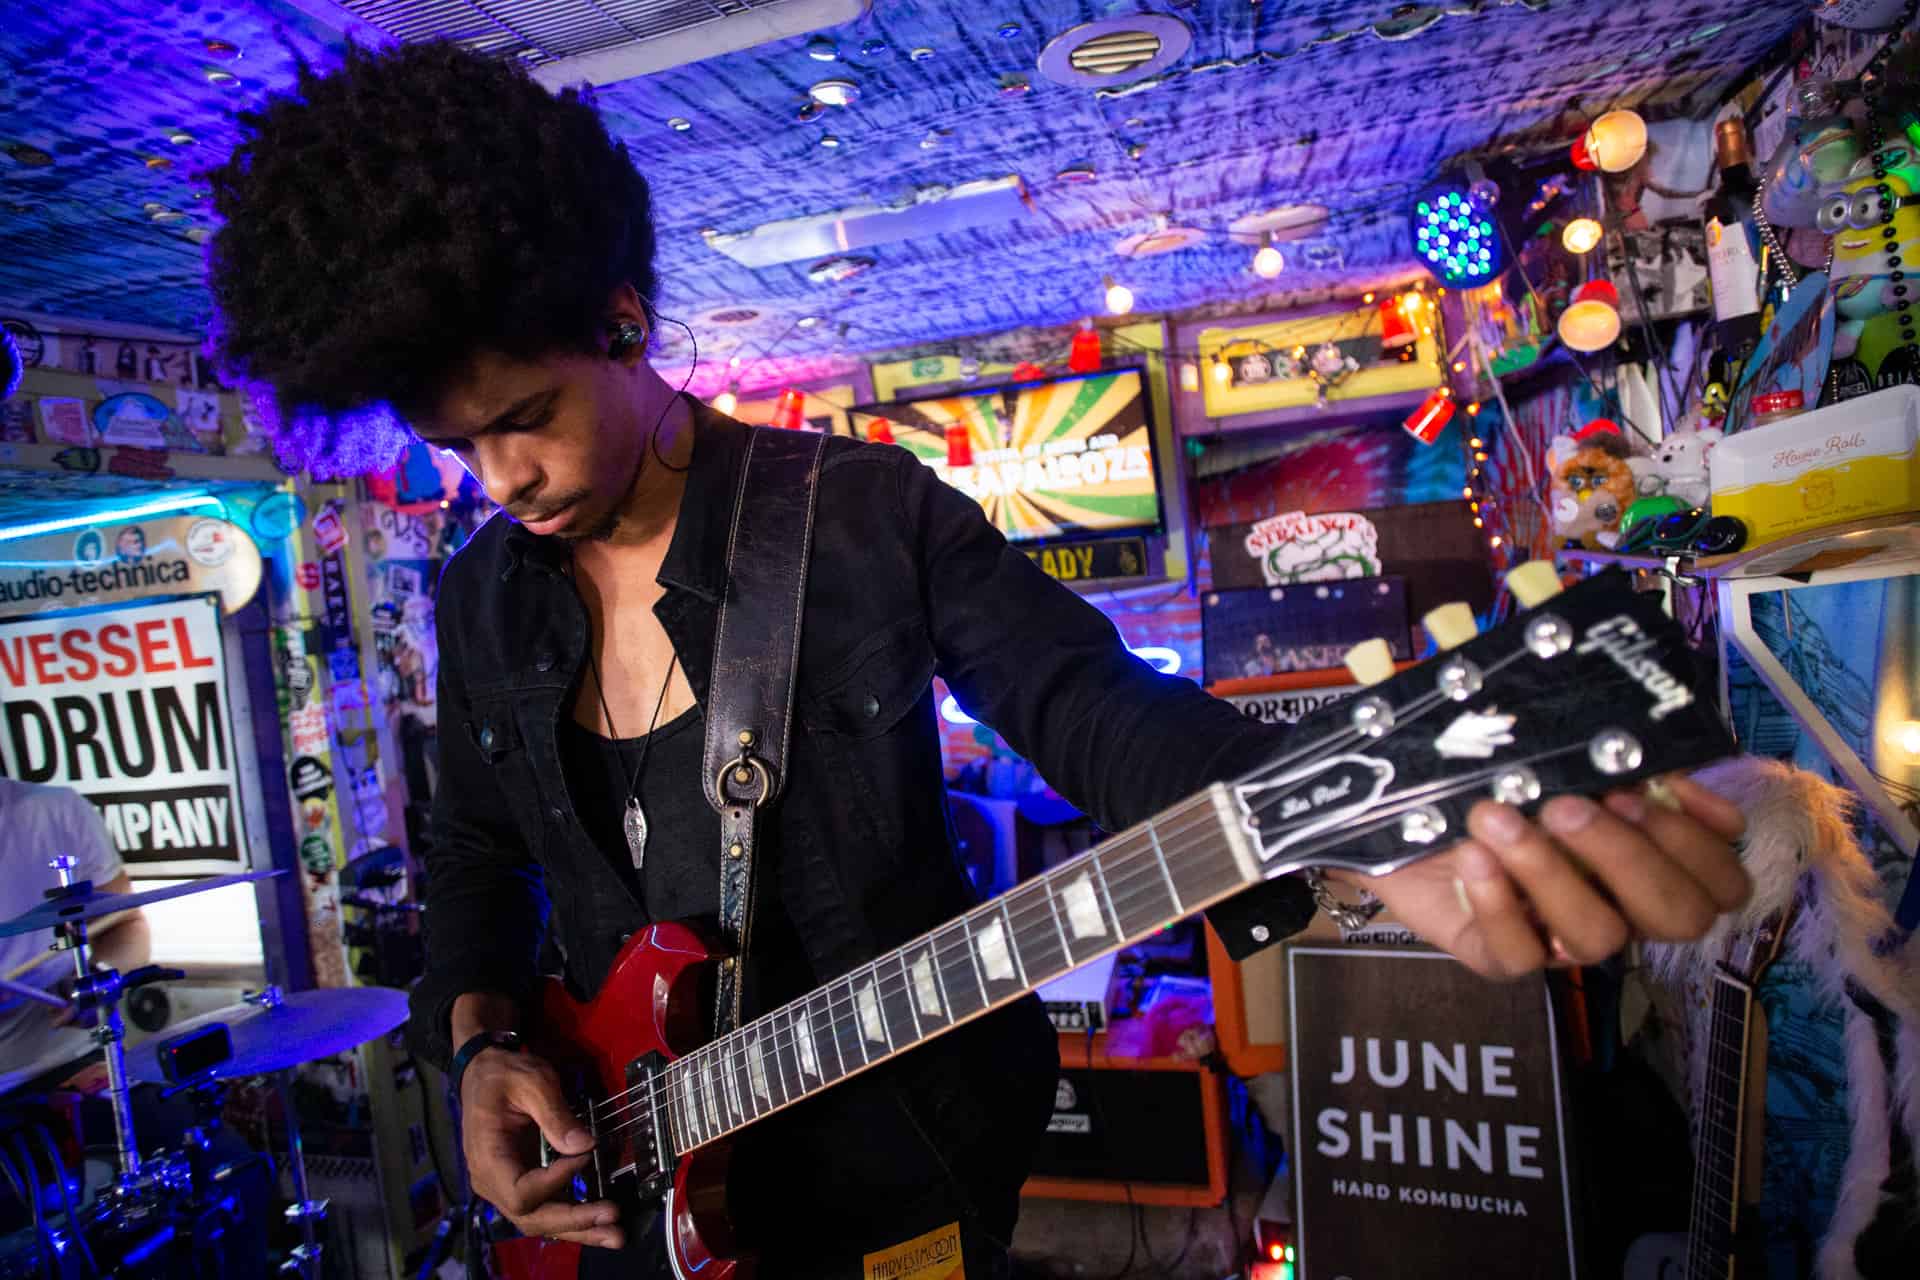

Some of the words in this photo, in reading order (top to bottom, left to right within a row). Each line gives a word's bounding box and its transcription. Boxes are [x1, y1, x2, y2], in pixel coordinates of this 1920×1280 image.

[0, 556, 190, 603] audio-technica
[0, 617, 214, 687] VESSEL
[1576, 614, 1694, 720] Gibson
[3, 681, 229, 784] DRUM
[1243, 691, 1352, 723] ORAN
[102, 796, 229, 852] MPANY
[1331, 1036, 1518, 1098] JUNE
[1316, 1107, 1545, 1180] SHINE
[1332, 1178, 1391, 1201] HARD
[1398, 1186, 1529, 1218] KOMBUCHA
